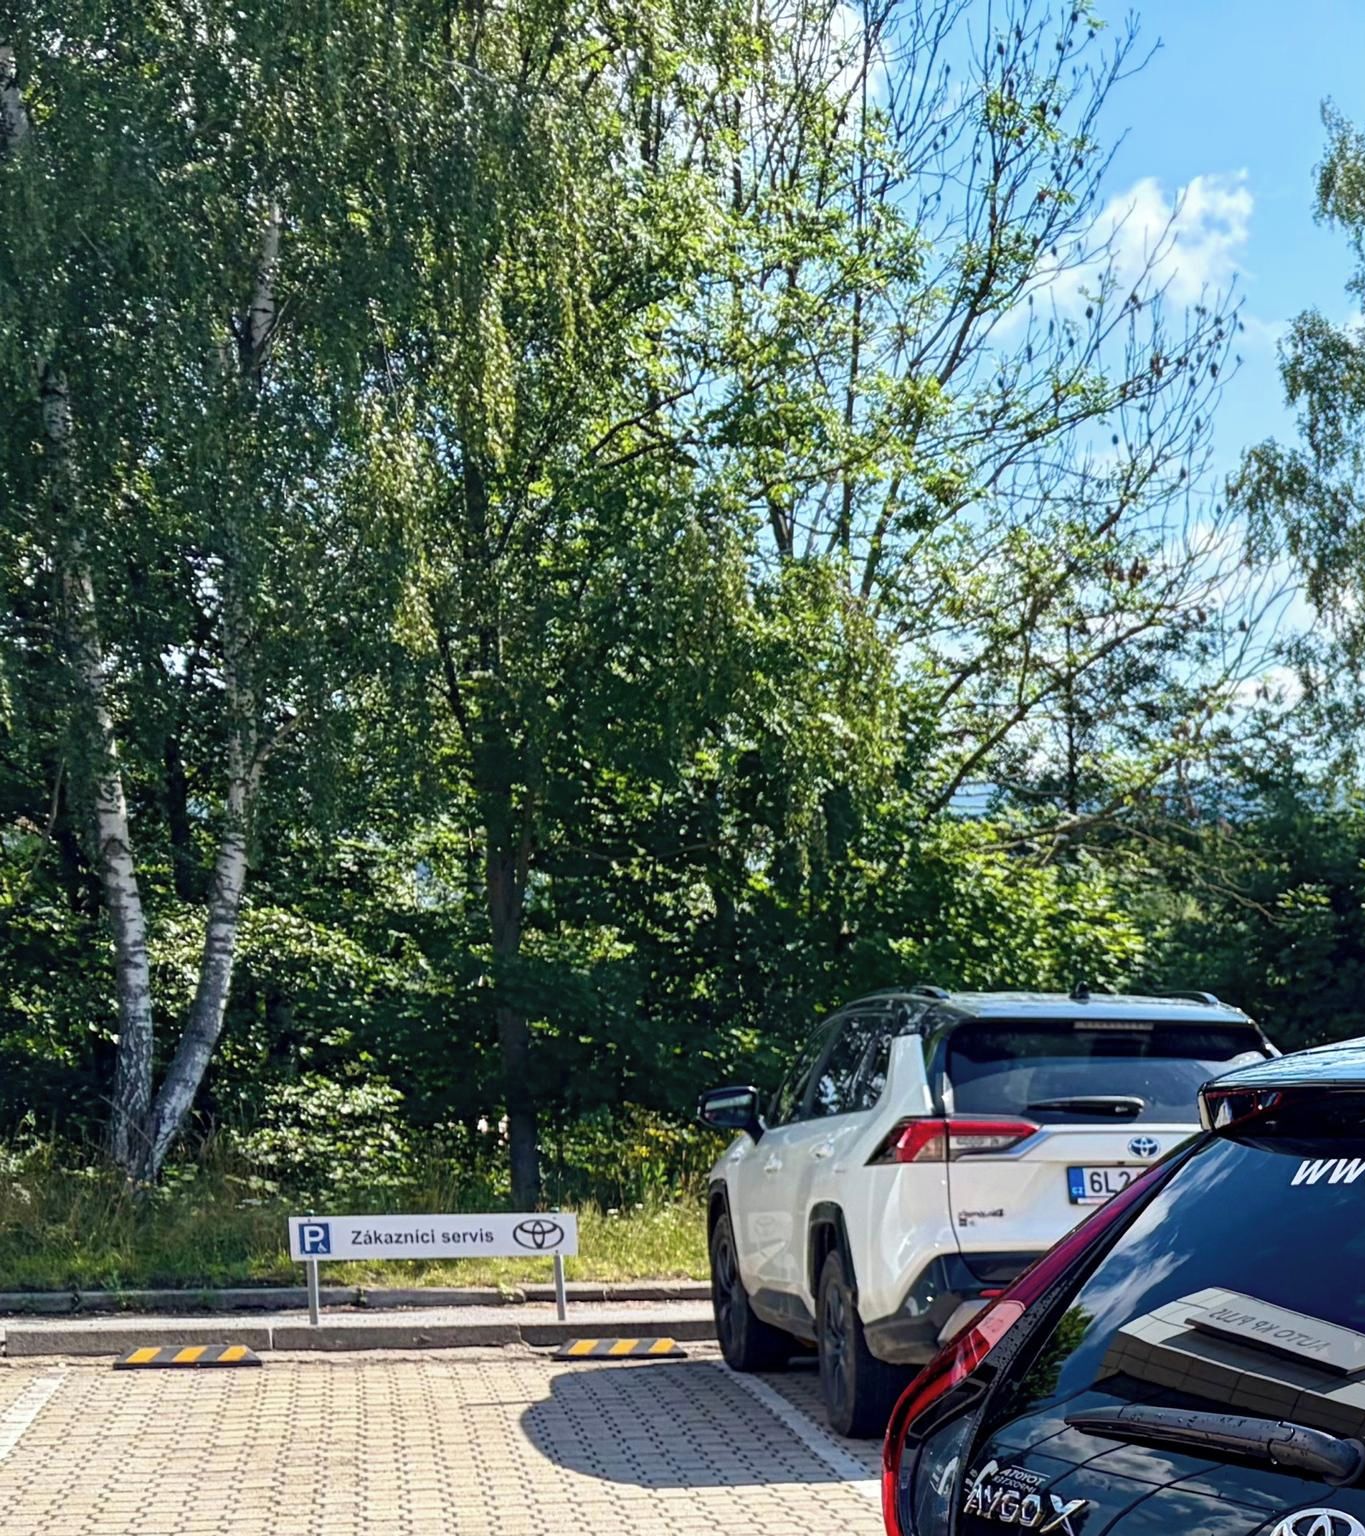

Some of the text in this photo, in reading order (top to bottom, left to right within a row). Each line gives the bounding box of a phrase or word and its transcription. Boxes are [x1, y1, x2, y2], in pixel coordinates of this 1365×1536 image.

[351, 1228, 494, 1246] Zákazníci servis
[964, 1483, 1041, 1527] AYGO
